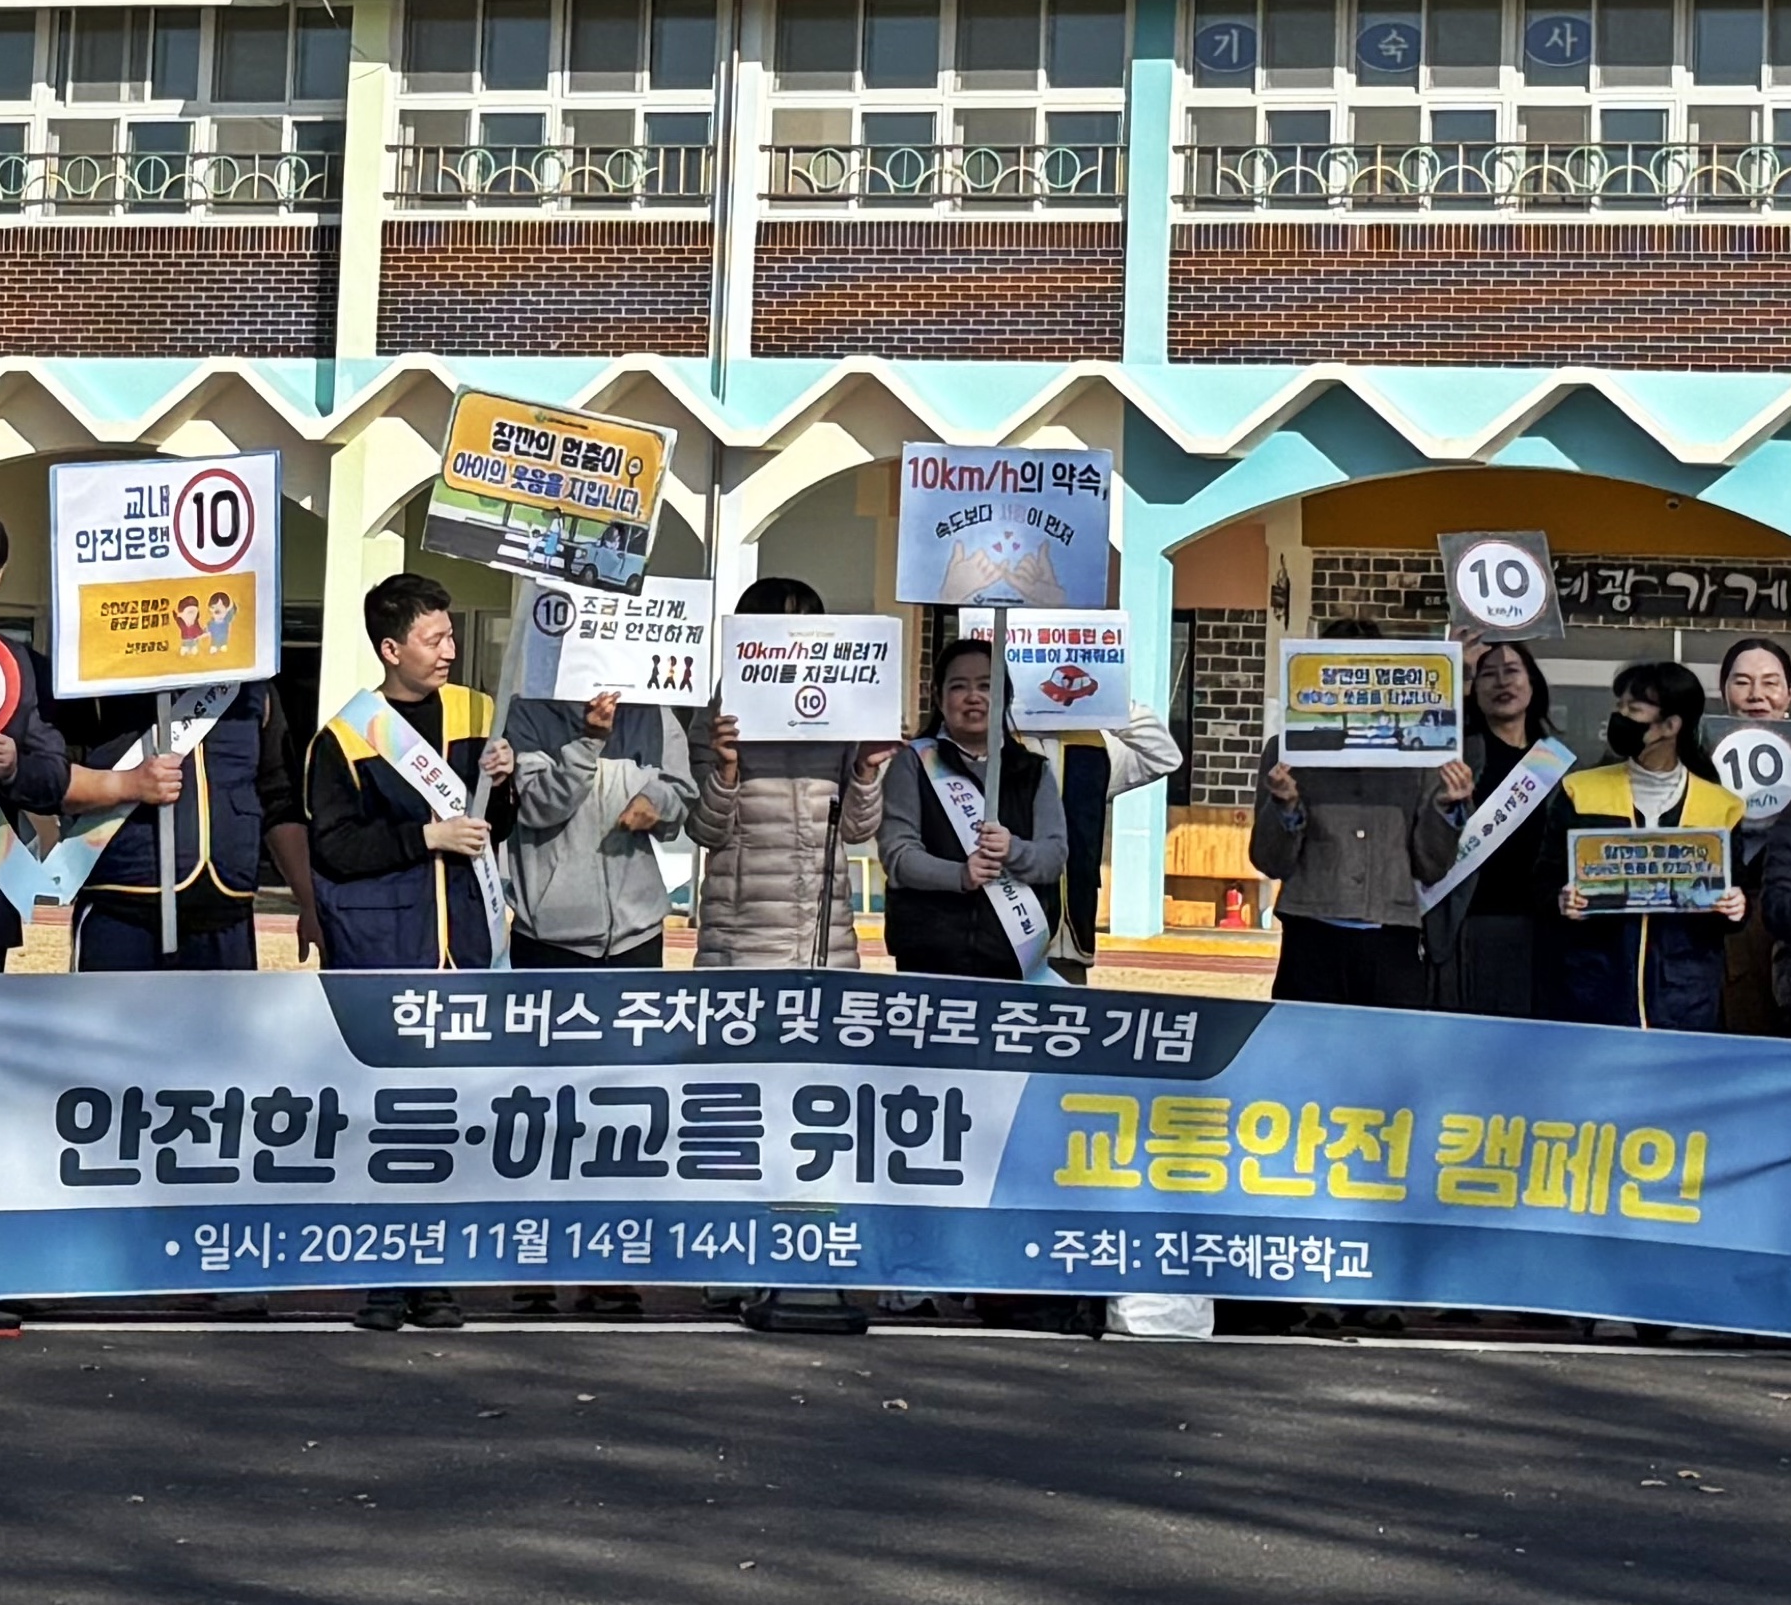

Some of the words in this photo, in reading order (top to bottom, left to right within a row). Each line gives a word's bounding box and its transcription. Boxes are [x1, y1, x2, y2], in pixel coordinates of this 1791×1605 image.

[453, 452, 507, 484] 아이의
[492, 421, 556, 462] 잠깐의
[560, 436, 624, 477] 멈춤이
[908, 456, 1044, 494] 10km/h의
[1051, 462, 1108, 501] 약속,
[124, 484, 171, 520] 교내
[192, 489, 241, 550] 10
[76, 525, 171, 564] 안전운행
[935, 503, 993, 540] 속도보다
[1044, 513, 1075, 546] 먼저
[1469, 558, 1531, 600] 10
[543, 599, 570, 627] 10
[736, 641, 828, 661] 10km/h의
[741, 664, 798, 684] 아이를
[802, 664, 881, 685] 지킵니다.
[801, 695, 821, 710] 10
[1722, 743, 1784, 791] 10
[391, 988, 491, 1048] 학교
[505, 990, 604, 1044] 버스
[612, 987, 765, 1047] 주차장
[776, 987, 823, 1046] 및
[830, 989, 983, 1050] 통학로
[991, 999, 1092, 1062] 준공
[1102, 1007, 1199, 1063] 기념
[53, 1085, 349, 1189] 안전한
[366, 1081, 766, 1185] 등·하교를
[790, 1082, 972, 1187] 위한
[1052, 1091, 1414, 1203] 교통안전
[1434, 1111, 1709, 1225] 캠페인
[193, 1222, 289, 1270] 일시:
[299, 1221, 446, 1266] 2025년
[459, 1220, 551, 1265] 11월
[564, 1221, 655, 1265] 14일
[668, 1221, 759, 1265] 14시
[770, 1220, 864, 1266] 30분
[1049, 1228, 1142, 1275] 주최:
[1152, 1230, 1374, 1284] 진주혜광학교
